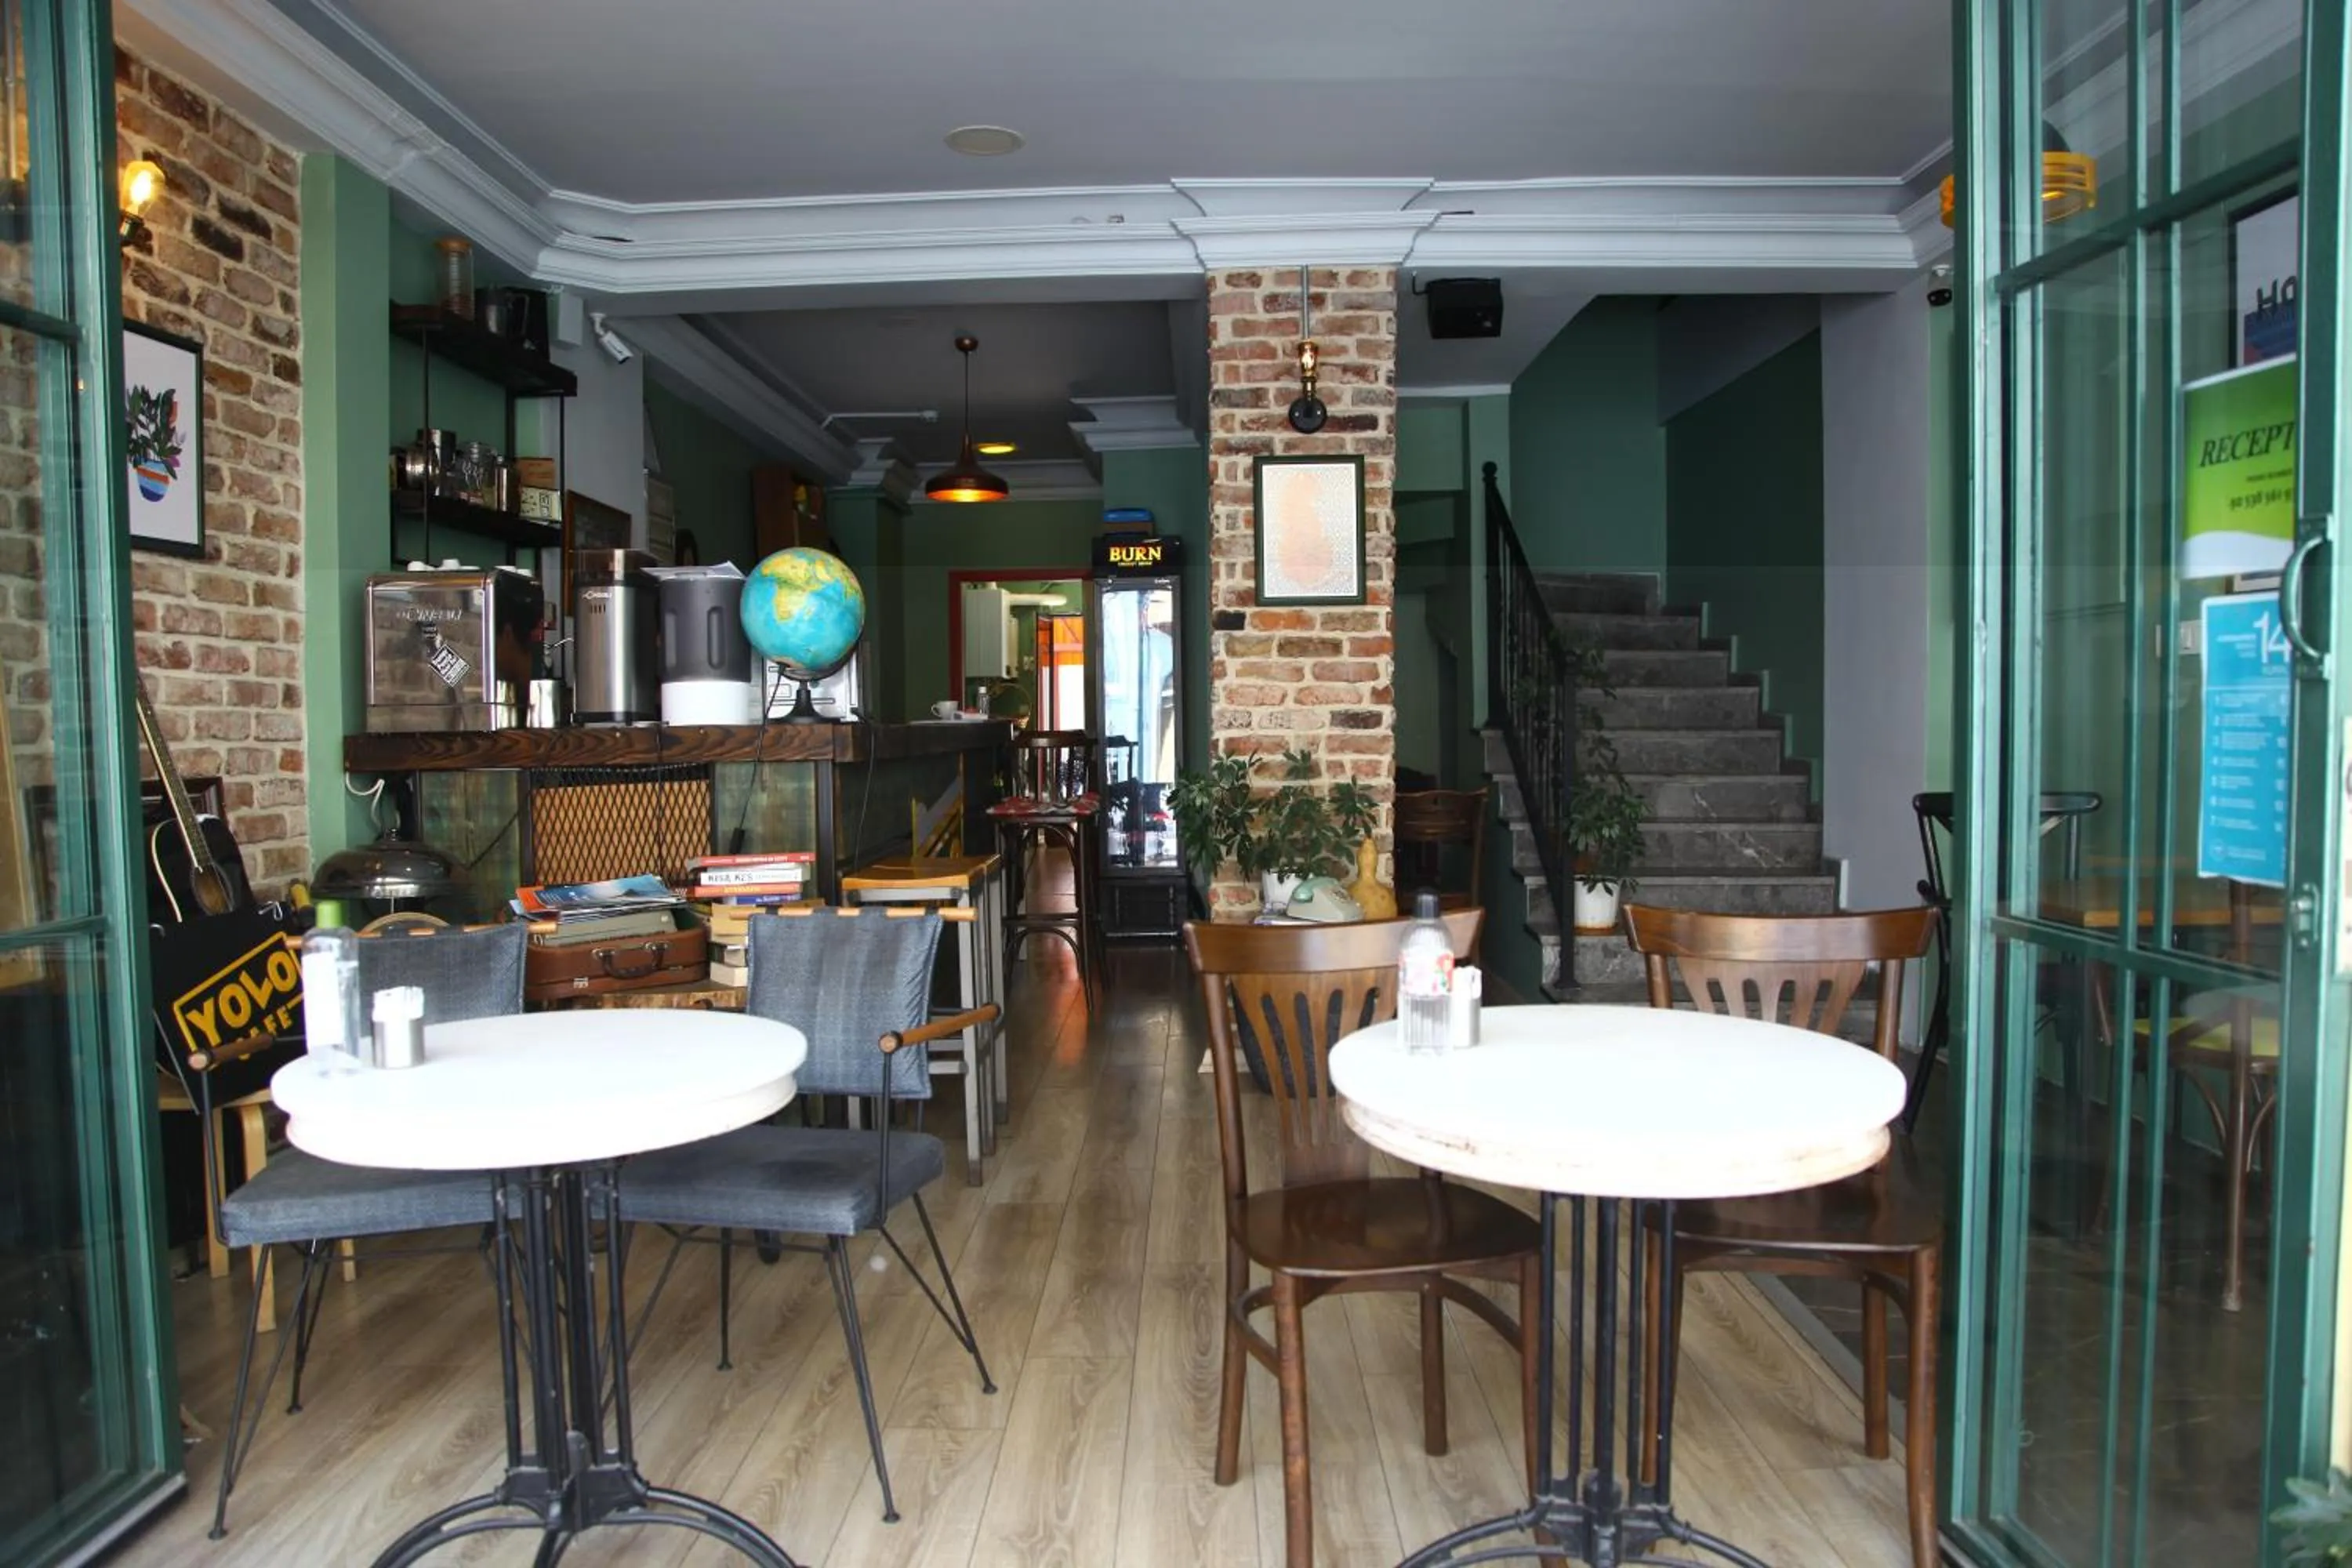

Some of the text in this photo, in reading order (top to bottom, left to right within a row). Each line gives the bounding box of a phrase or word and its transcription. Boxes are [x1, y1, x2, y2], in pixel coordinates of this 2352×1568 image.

[2198, 422, 2294, 468] RECEPT
[1109, 546, 1162, 562] BURN
[2252, 611, 2292, 664] 14
[186, 951, 297, 1047] YOLO
[238, 1006, 292, 1060] FE
